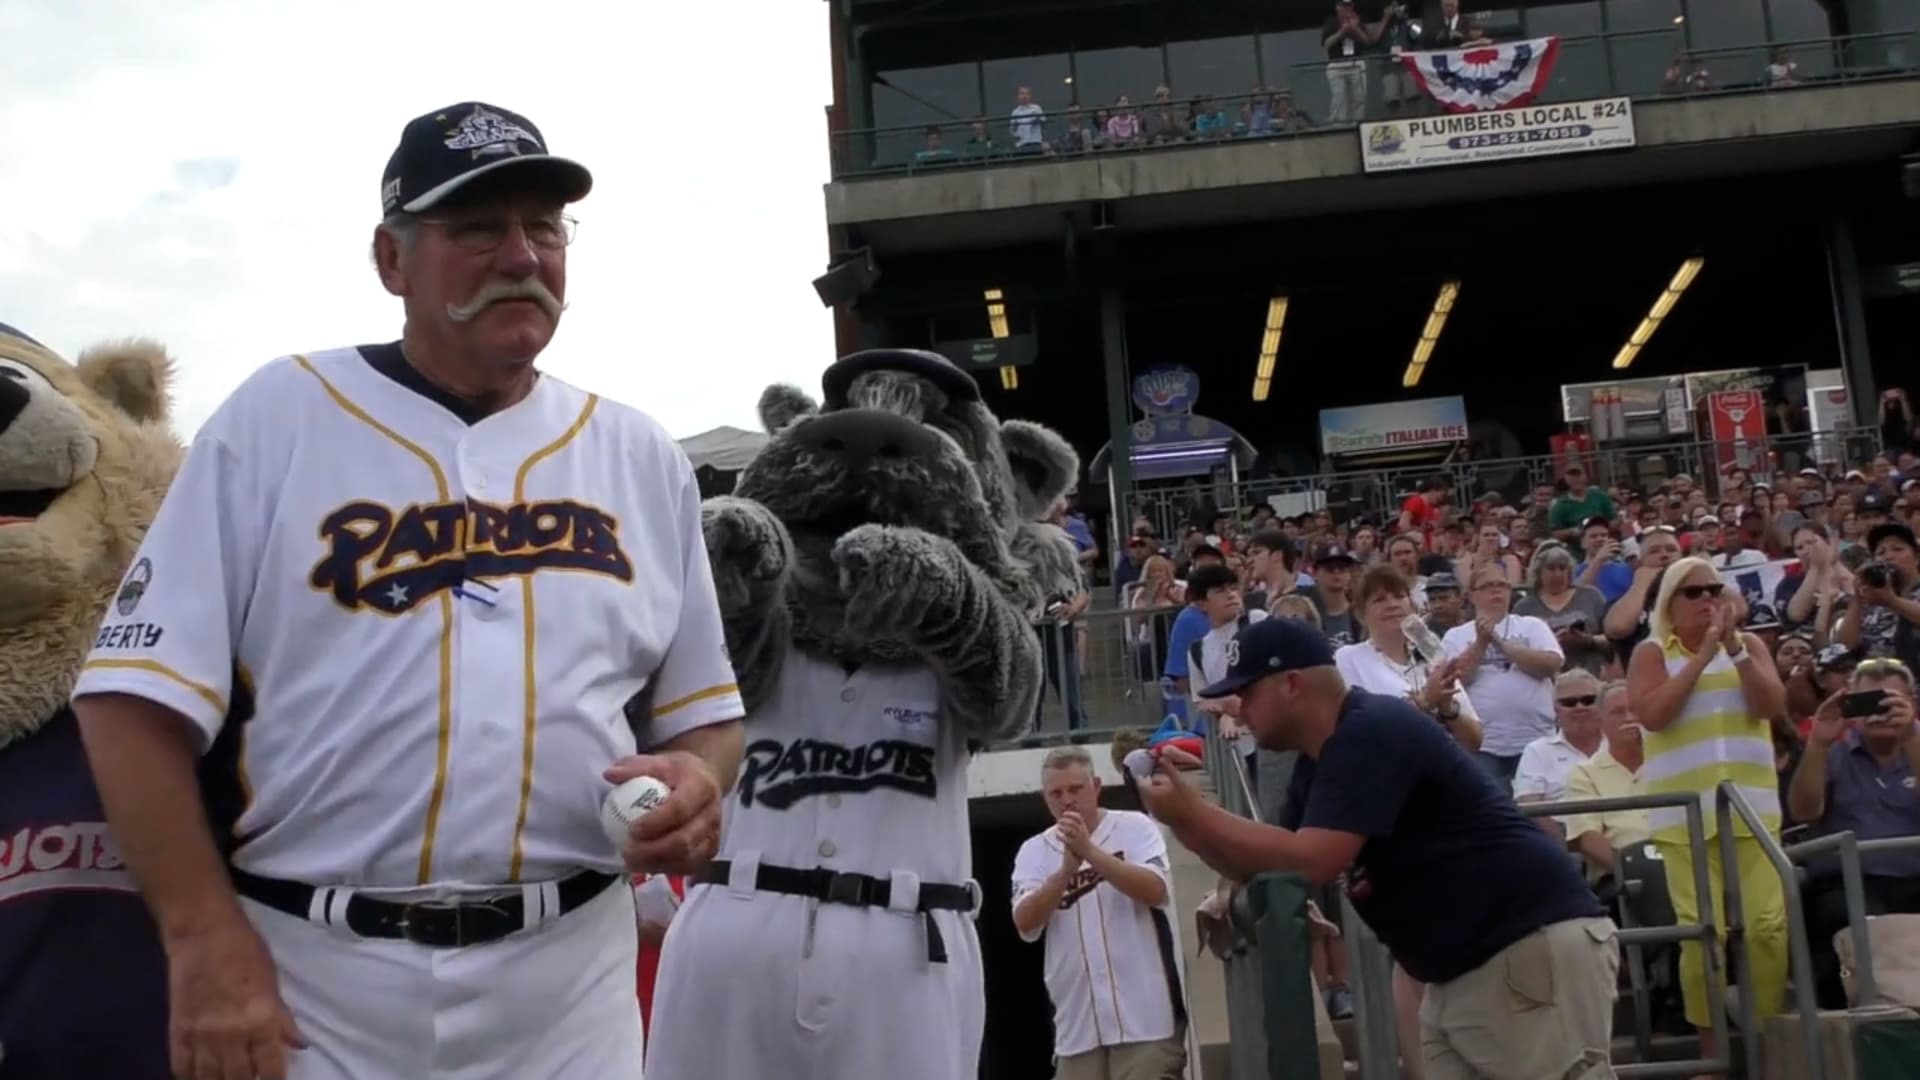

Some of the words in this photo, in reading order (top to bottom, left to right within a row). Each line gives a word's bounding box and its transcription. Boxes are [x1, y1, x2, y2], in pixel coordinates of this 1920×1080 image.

[1409, 112, 1515, 137] PLUMBERS
[1523, 106, 1587, 126] LOCAL
[1593, 102, 1627, 118] #24
[1385, 427, 1438, 445] ITALIAN
[1443, 425, 1466, 439] ICE
[309, 498, 634, 611] PATRIOTS
[738, 738, 937, 808] PATRIOTS
